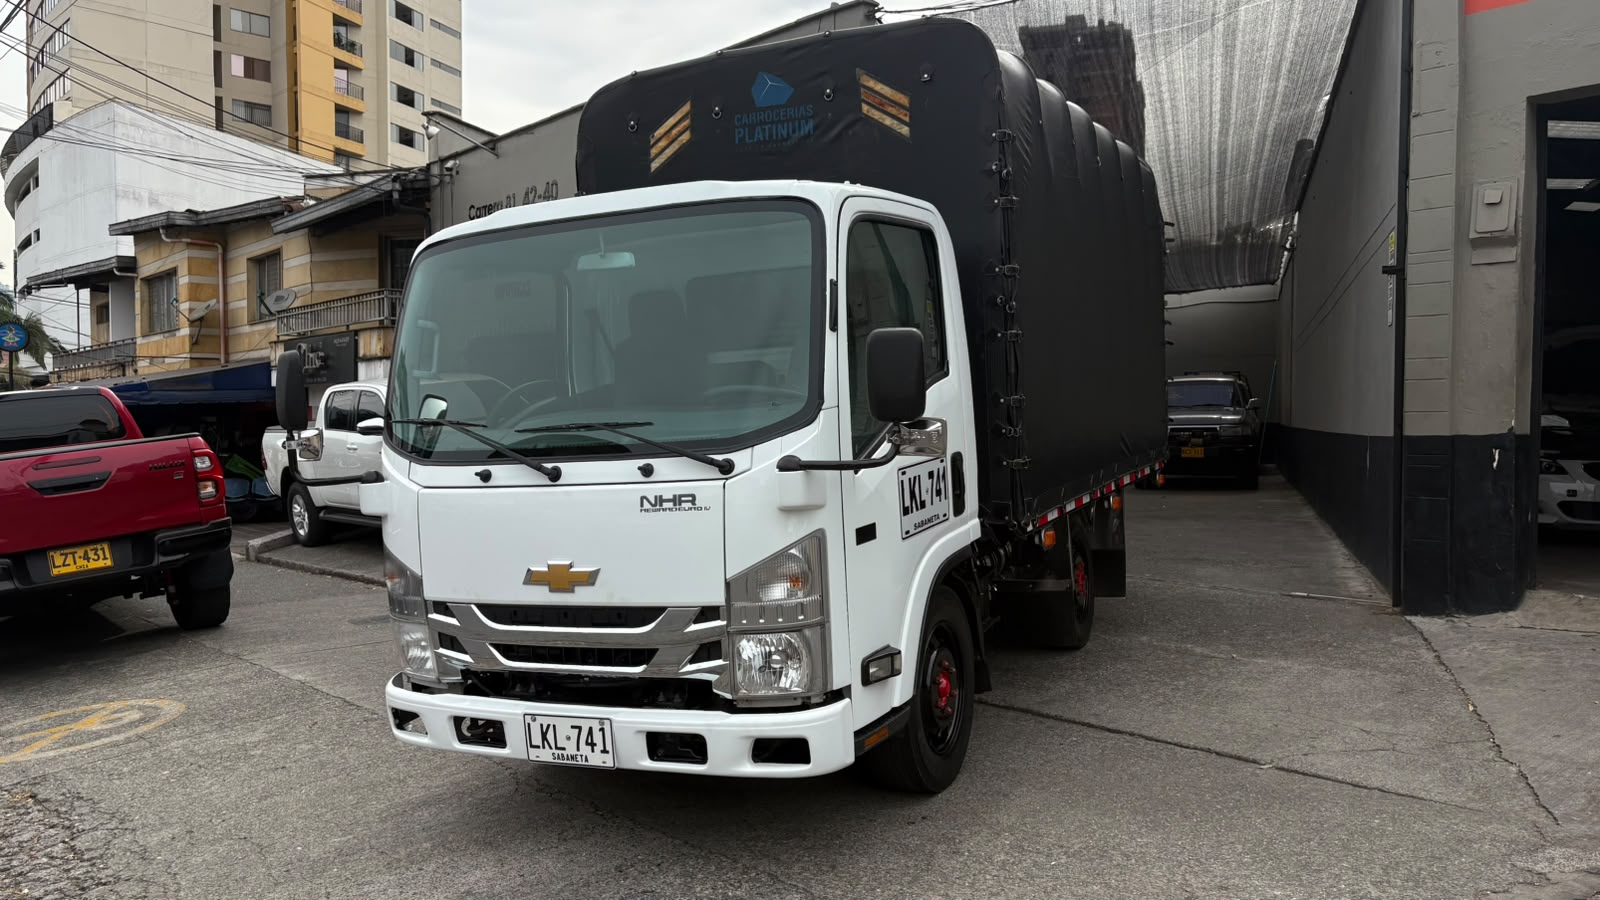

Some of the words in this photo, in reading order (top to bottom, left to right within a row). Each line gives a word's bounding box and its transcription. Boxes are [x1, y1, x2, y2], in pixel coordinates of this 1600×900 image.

[735, 104, 814, 127] CARROCERIAS
[735, 118, 815, 144] PLATINUM
[522, 179, 559, 205] 42-40
[639, 493, 697, 508] NHR
[914, 513, 940, 530] SABANETA
[552, 752, 589, 763] SABANETA
